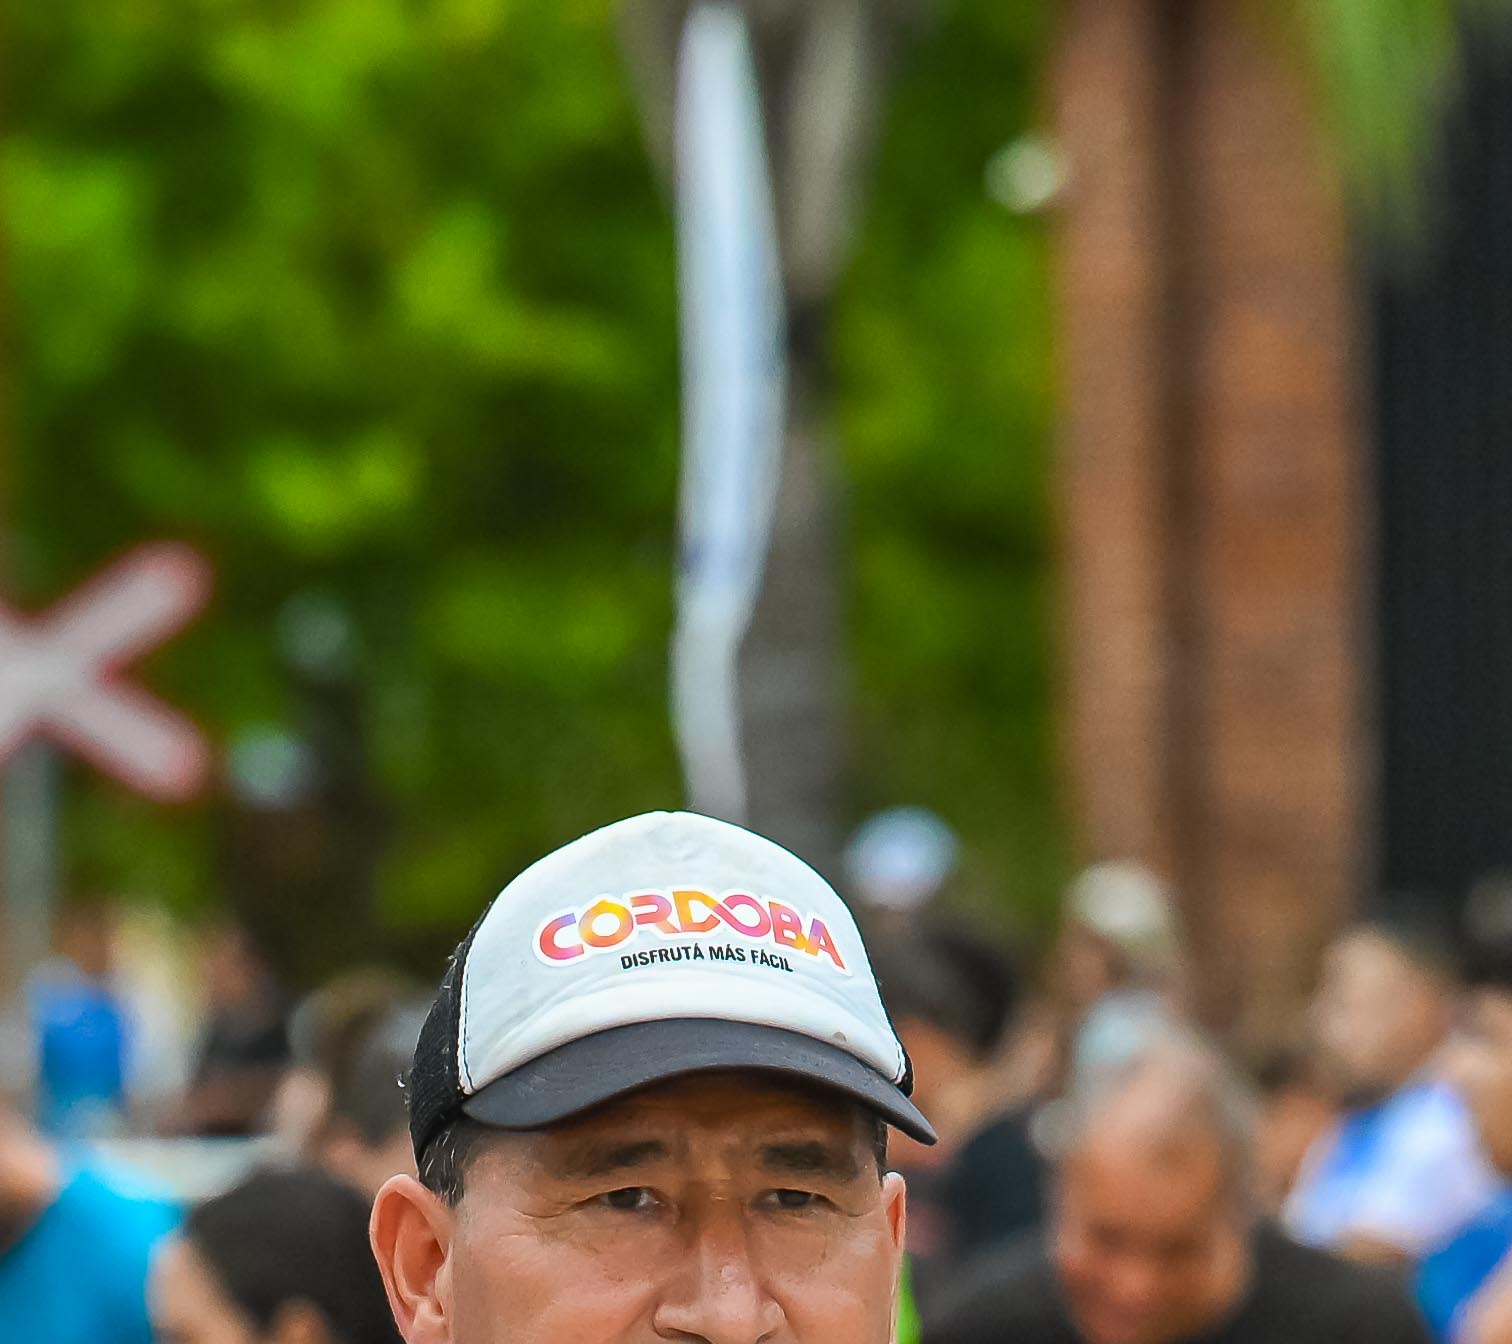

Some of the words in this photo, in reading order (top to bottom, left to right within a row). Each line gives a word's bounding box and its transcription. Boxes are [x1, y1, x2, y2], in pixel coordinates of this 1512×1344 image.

[621, 943, 704, 970] DISFRUTÁ
[709, 943, 745, 962] MÁS
[751, 949, 794, 972] FÁCIL
